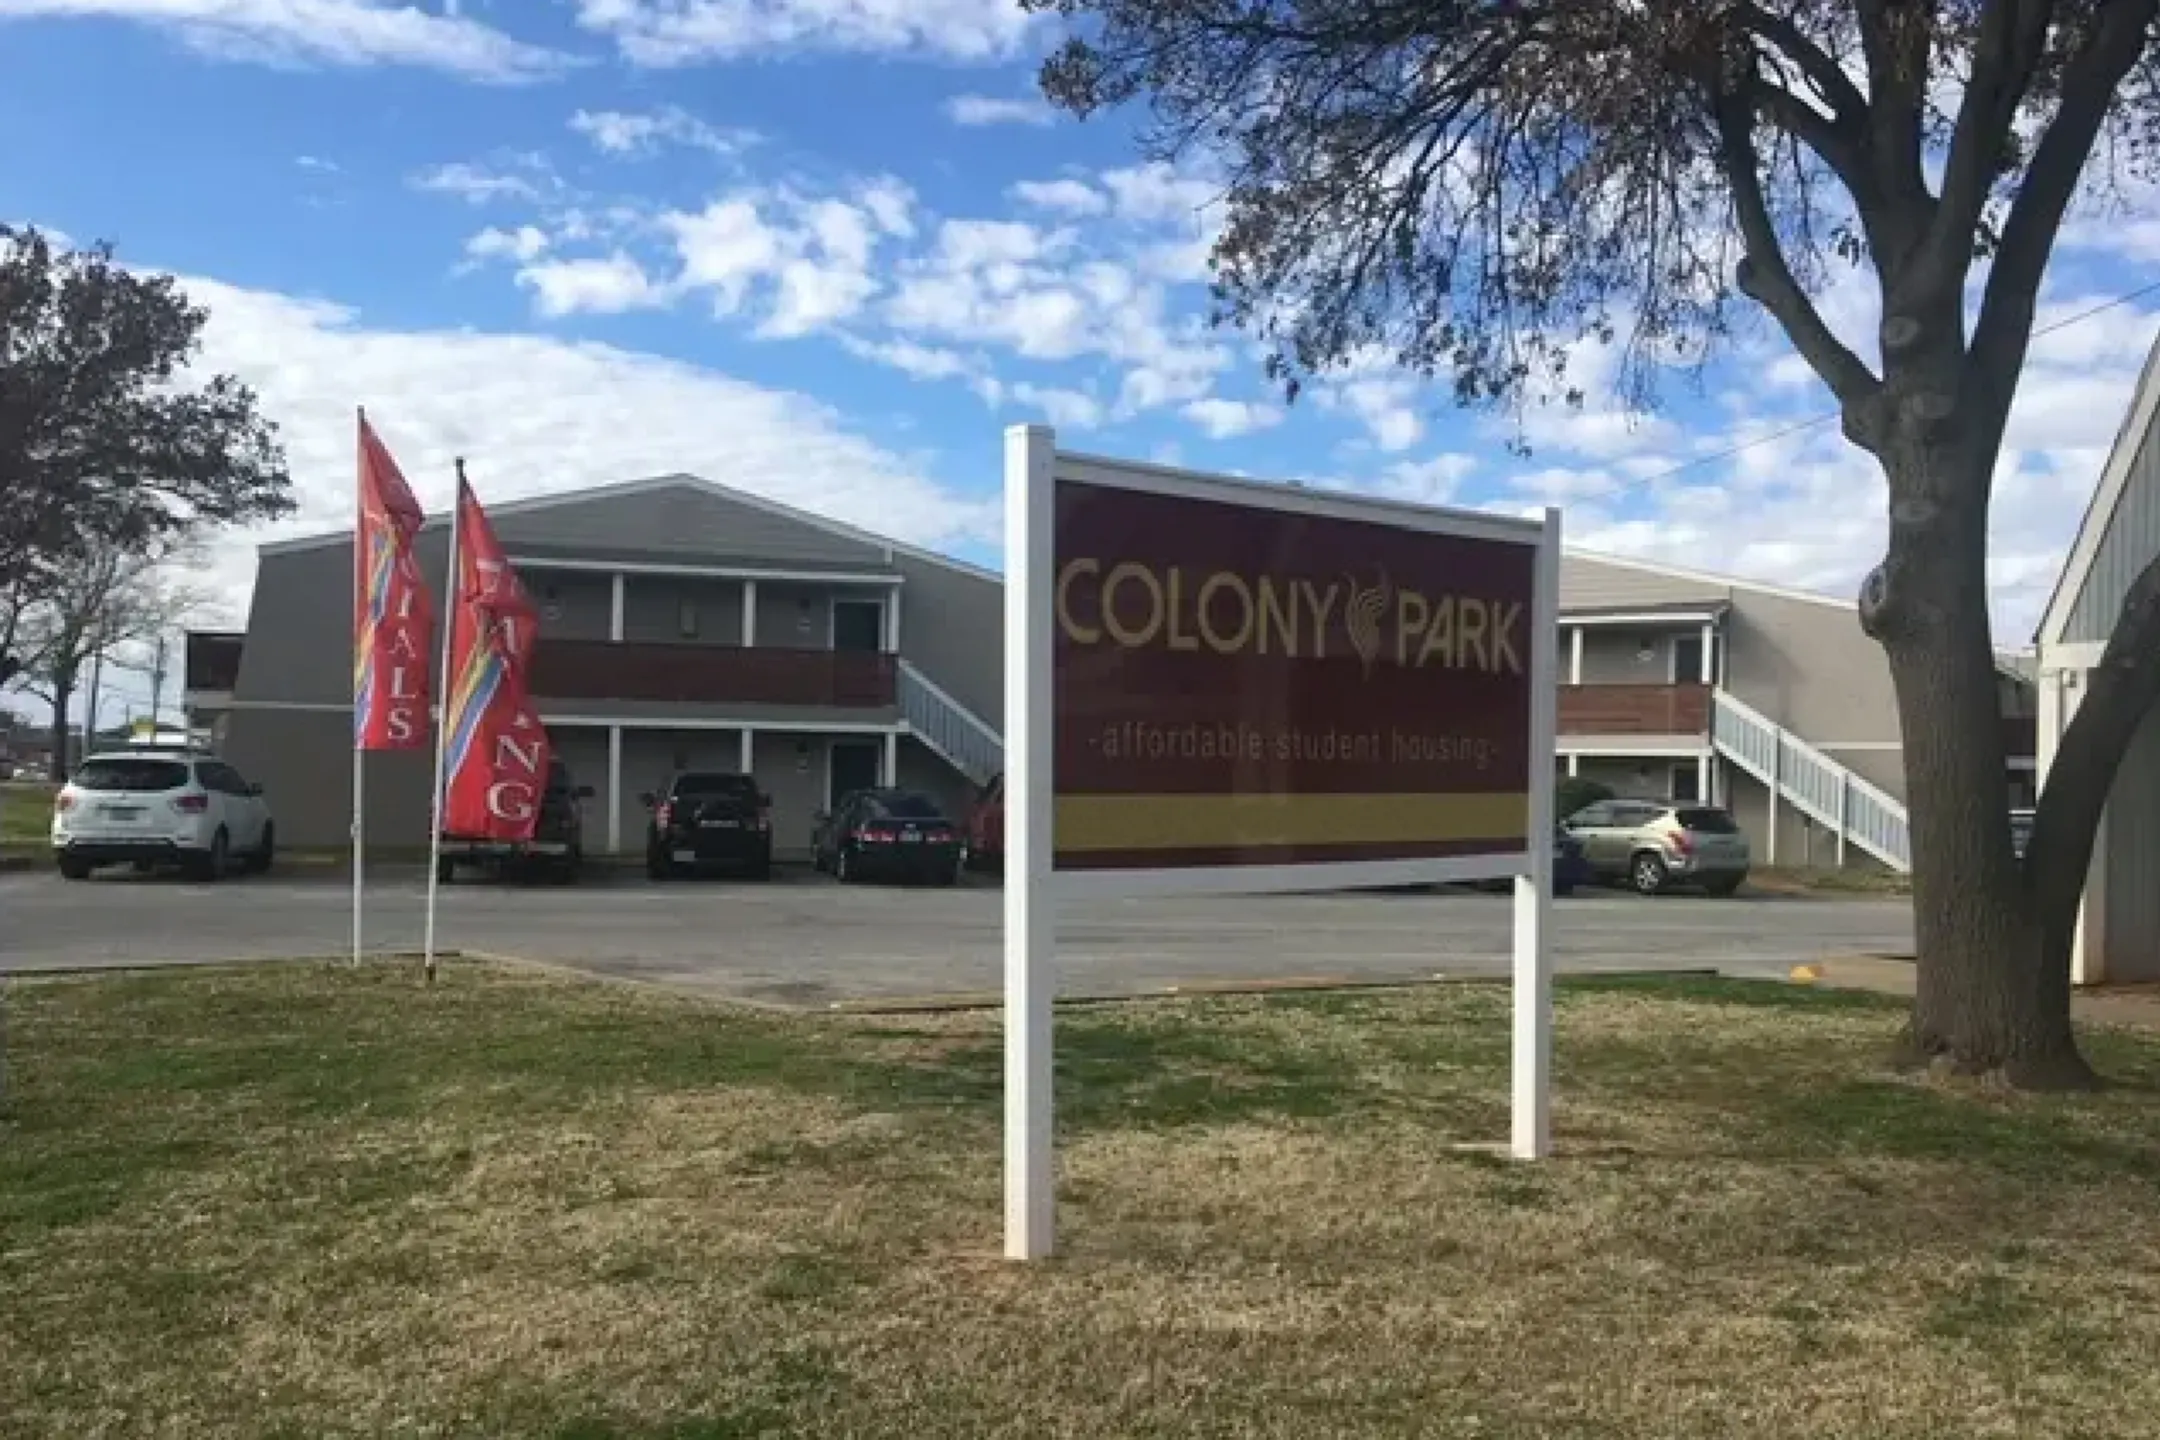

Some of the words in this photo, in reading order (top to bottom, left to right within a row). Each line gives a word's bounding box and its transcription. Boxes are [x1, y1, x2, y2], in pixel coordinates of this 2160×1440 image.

[1057, 557, 1339, 658] COLONY
[1397, 588, 1523, 674] PARK
[1275, 724, 1381, 762] student
